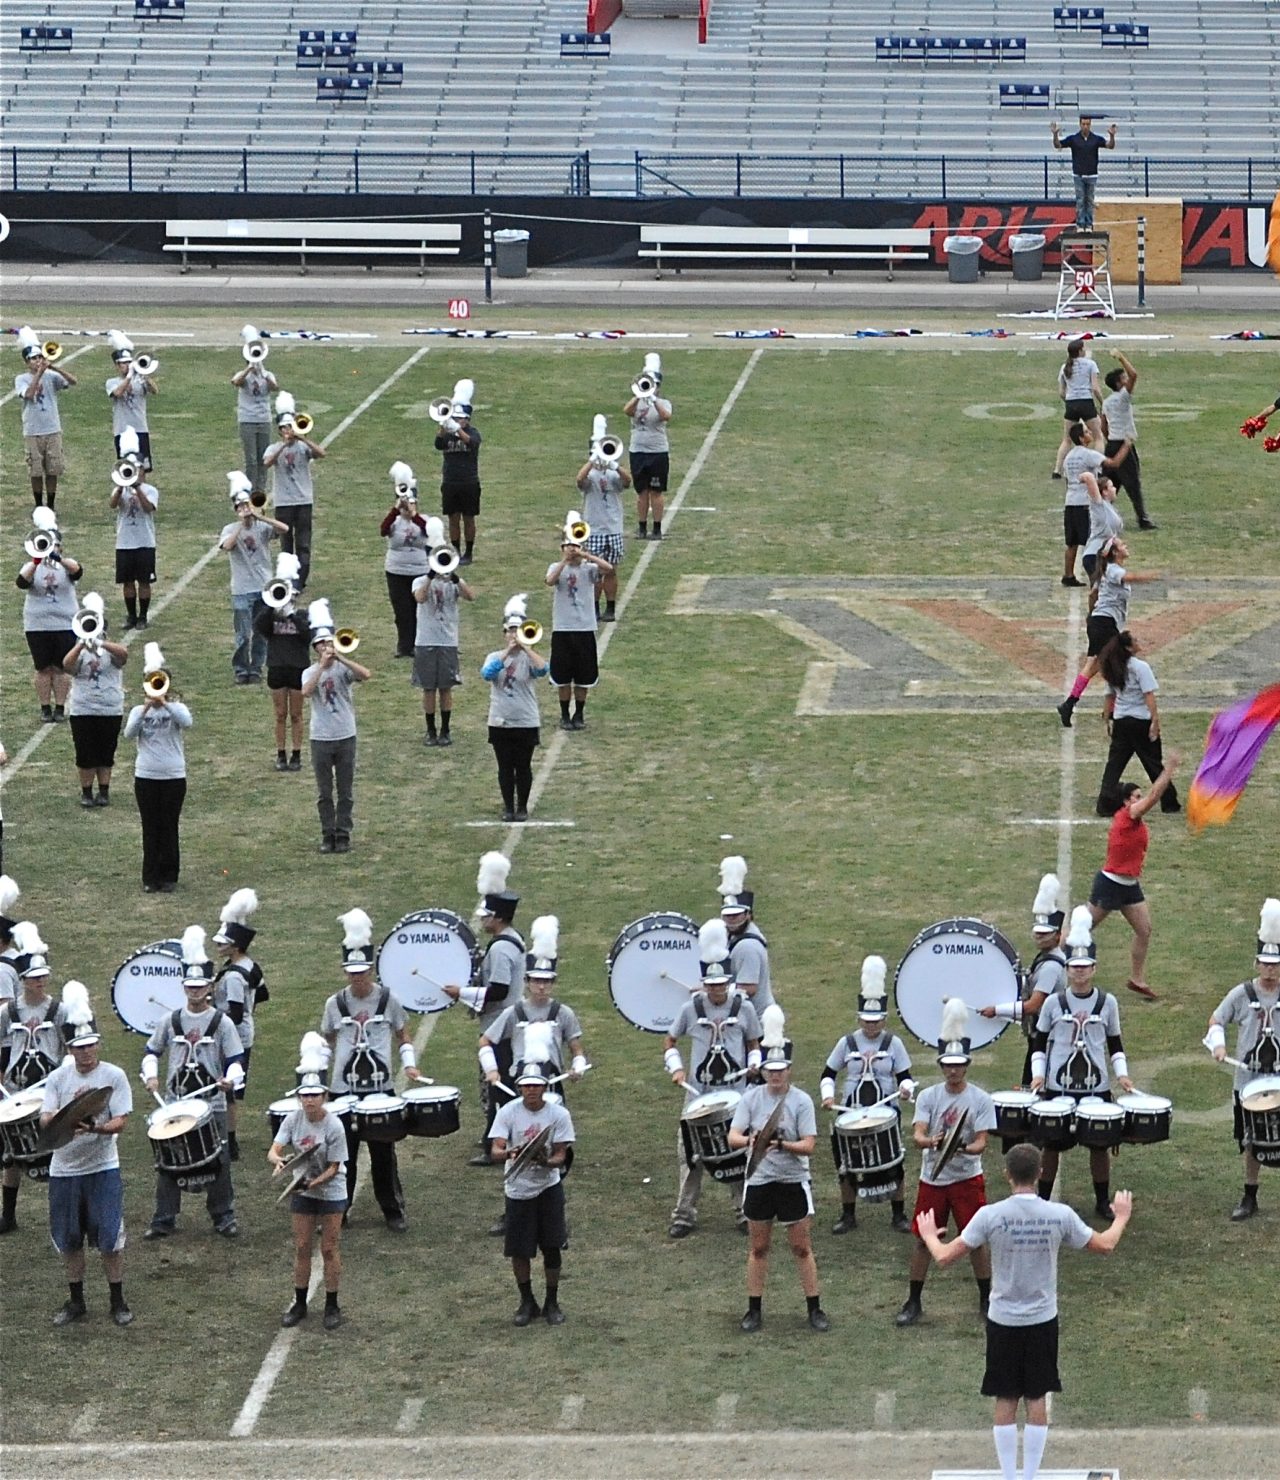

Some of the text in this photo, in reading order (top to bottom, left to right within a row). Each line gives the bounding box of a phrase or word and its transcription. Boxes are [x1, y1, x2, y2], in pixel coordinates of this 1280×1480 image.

[903, 206, 1247, 266] ARIZA
[1076, 271, 1093, 287] 50
[449, 300, 468, 317] 40
[410, 933, 450, 944] YAMAHA
[652, 939, 692, 951] YAMAHA
[945, 944, 984, 955] YAMAHA
[143, 966, 182, 977] YAMAHA
[724, 1164, 746, 1177] YAMA
[868, 1181, 898, 1196] YAMAHA
